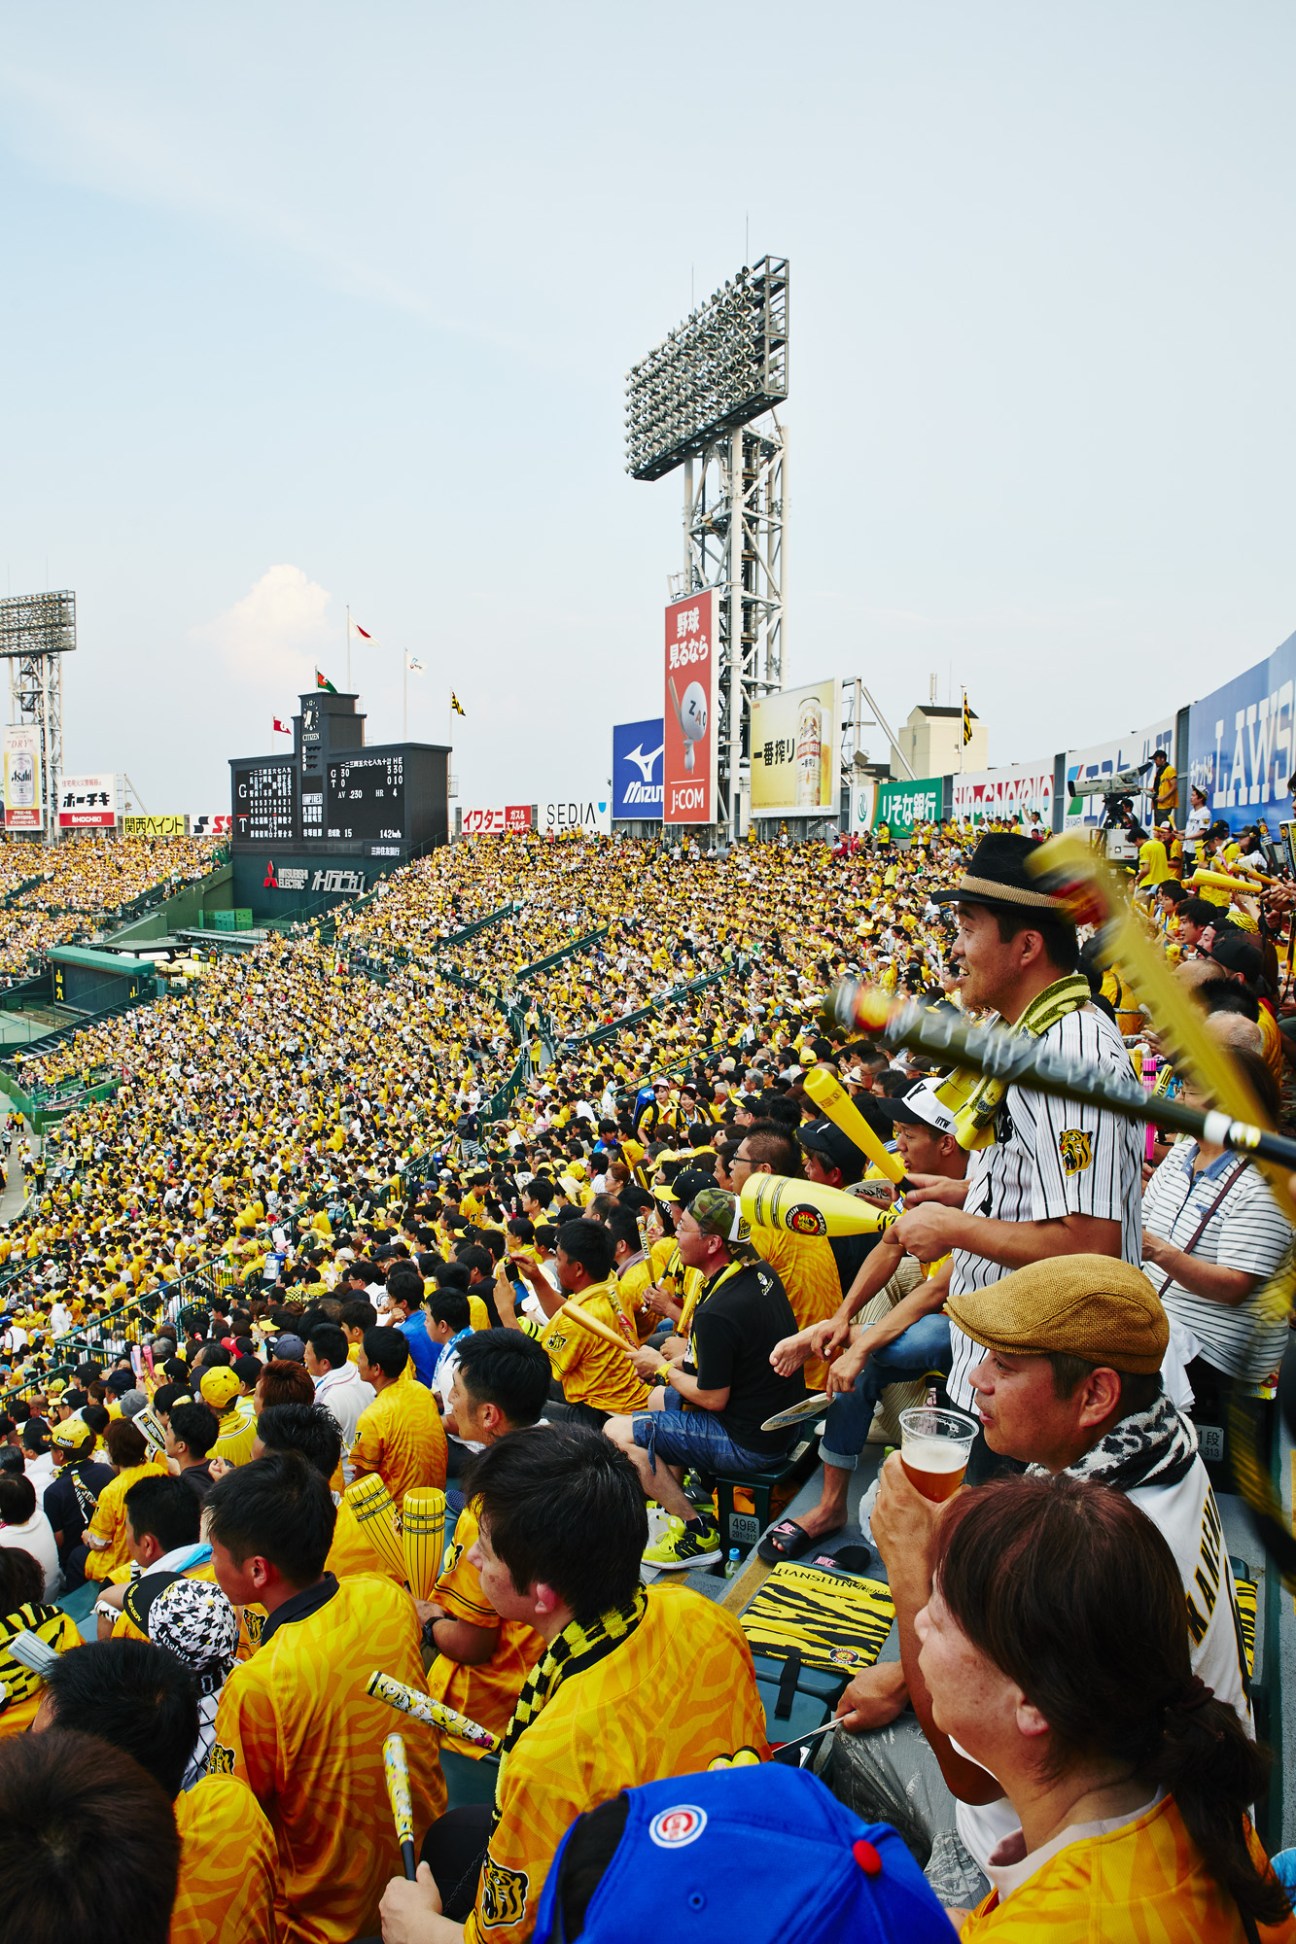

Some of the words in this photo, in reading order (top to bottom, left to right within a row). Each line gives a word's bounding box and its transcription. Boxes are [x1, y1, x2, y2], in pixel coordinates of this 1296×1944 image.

[677, 607, 699, 637] 野球
[670, 635, 708, 670] 見るなら
[302, 733, 320, 742] CITIZEN
[754, 738, 795, 766] 一番搾り
[12, 769, 31, 782] Asahi
[63, 792, 110, 808] ホーチキ
[238, 784, 247, 798] G
[671, 788, 704, 814] J:COM
[882, 792, 936, 826] りそな銀行
[464, 808, 504, 830] イワタニ
[547, 802, 596, 825] SEDIA
[125, 817, 183, 834] 関西ペイント
[239, 818, 247, 832] T
[278, 878, 305, 890] ELECTRIC
[908, 1082, 927, 1100] Y
[732, 1518, 756, 1534] 49段
[778, 1568, 853, 1588] HANSHIN
[158, 1630, 191, 1662] Joshin
